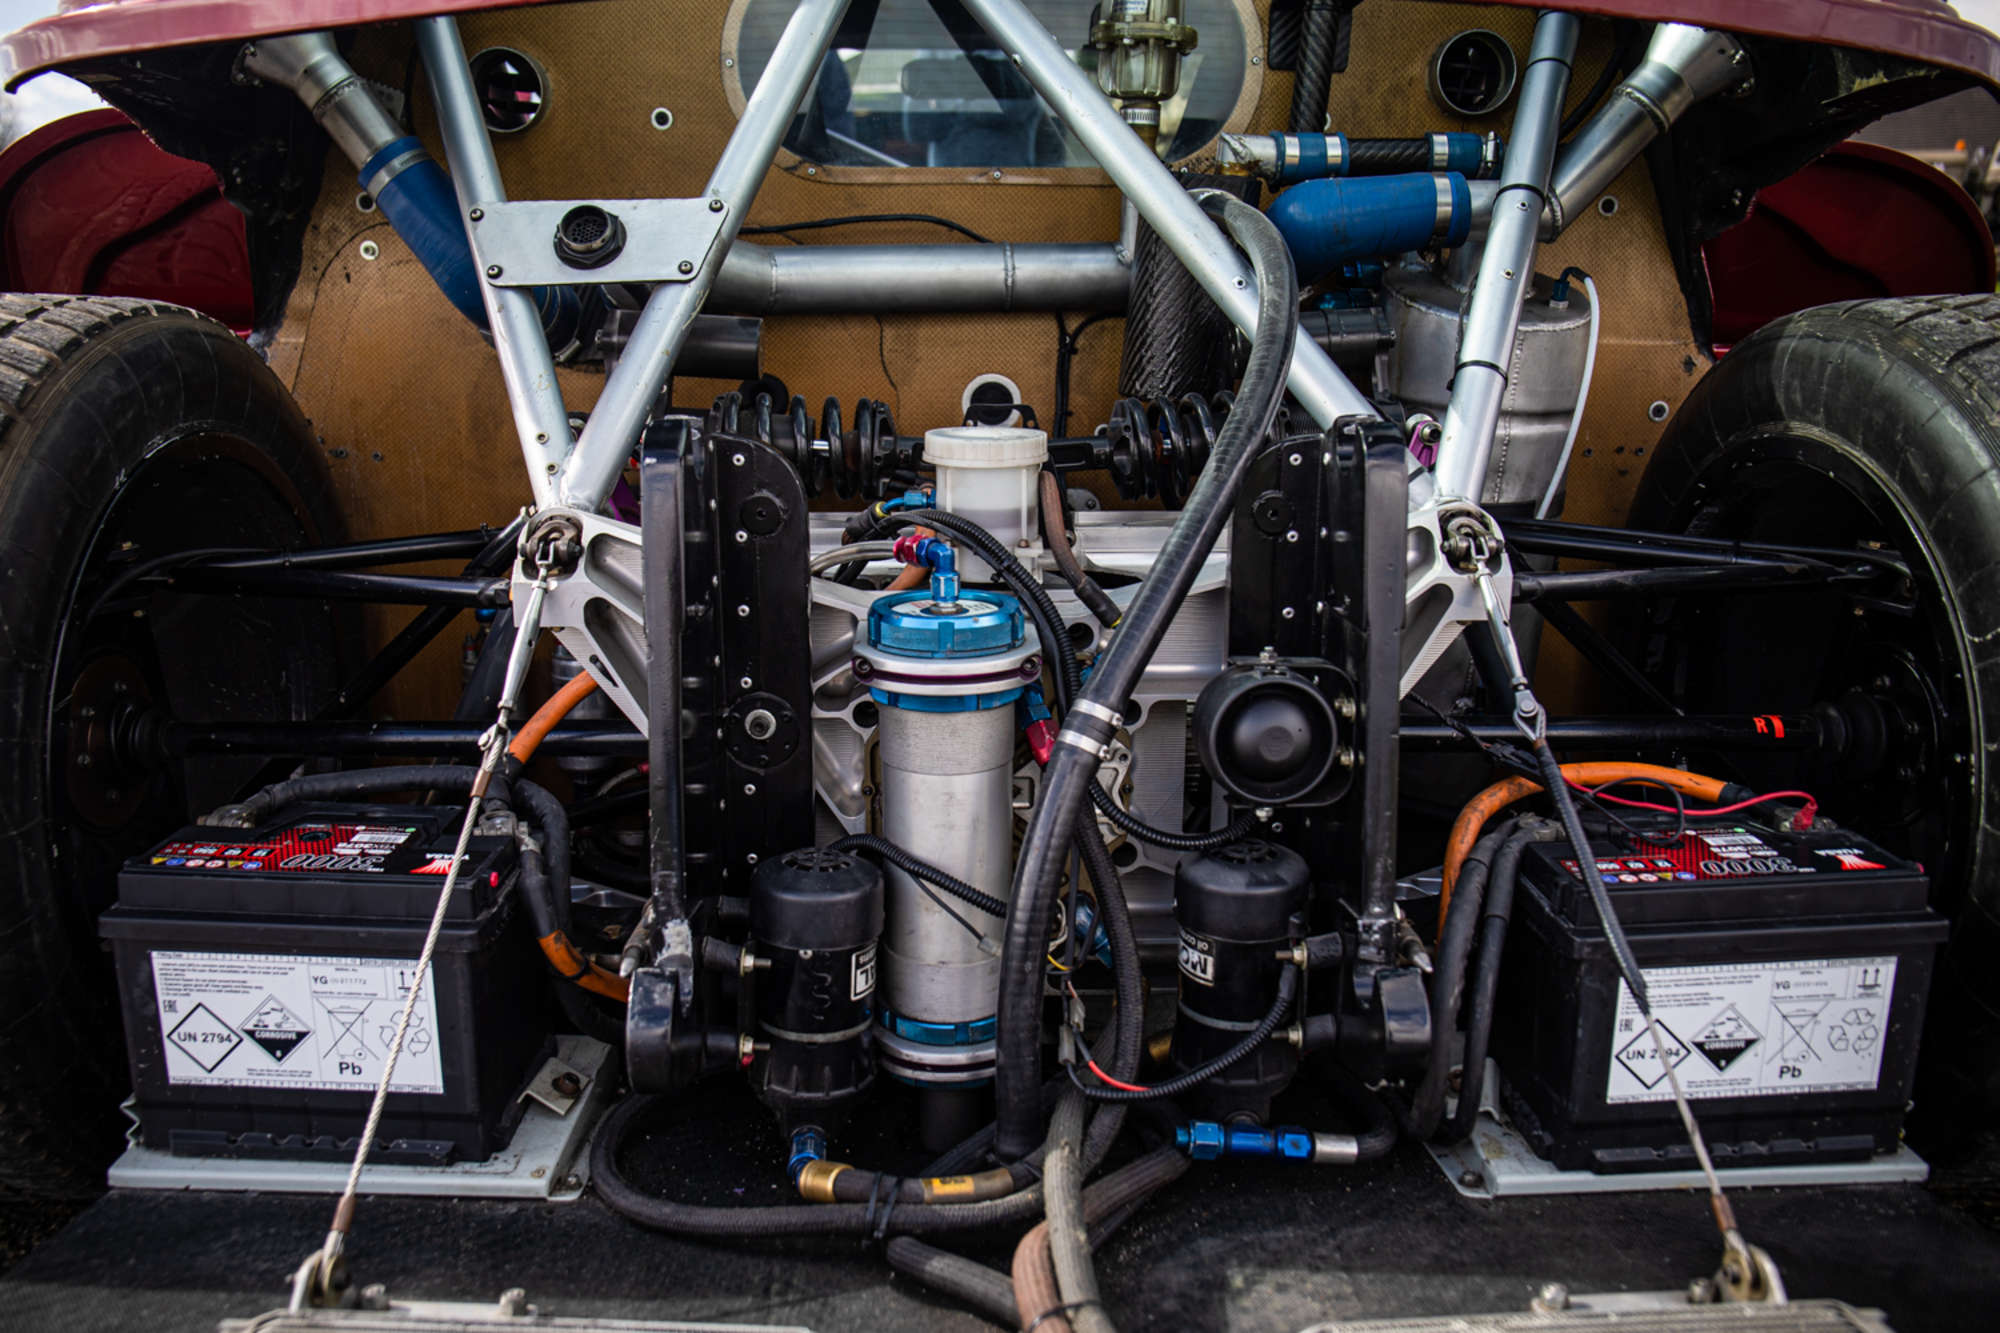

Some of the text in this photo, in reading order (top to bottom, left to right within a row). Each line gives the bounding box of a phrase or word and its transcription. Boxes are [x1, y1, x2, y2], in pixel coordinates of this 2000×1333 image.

[281, 853, 384, 871] 3000
[425, 852, 470, 861] YASA
[1700, 857, 1798, 876] 3000
[312, 975, 328, 985] YG
[1775, 980, 1791, 990] YG
[177, 1032, 233, 1044] UN 2794
[1626, 1049, 1646, 1060] UN
[339, 1061, 362, 1075] Pb
[1779, 1065, 1802, 1078] Pb
